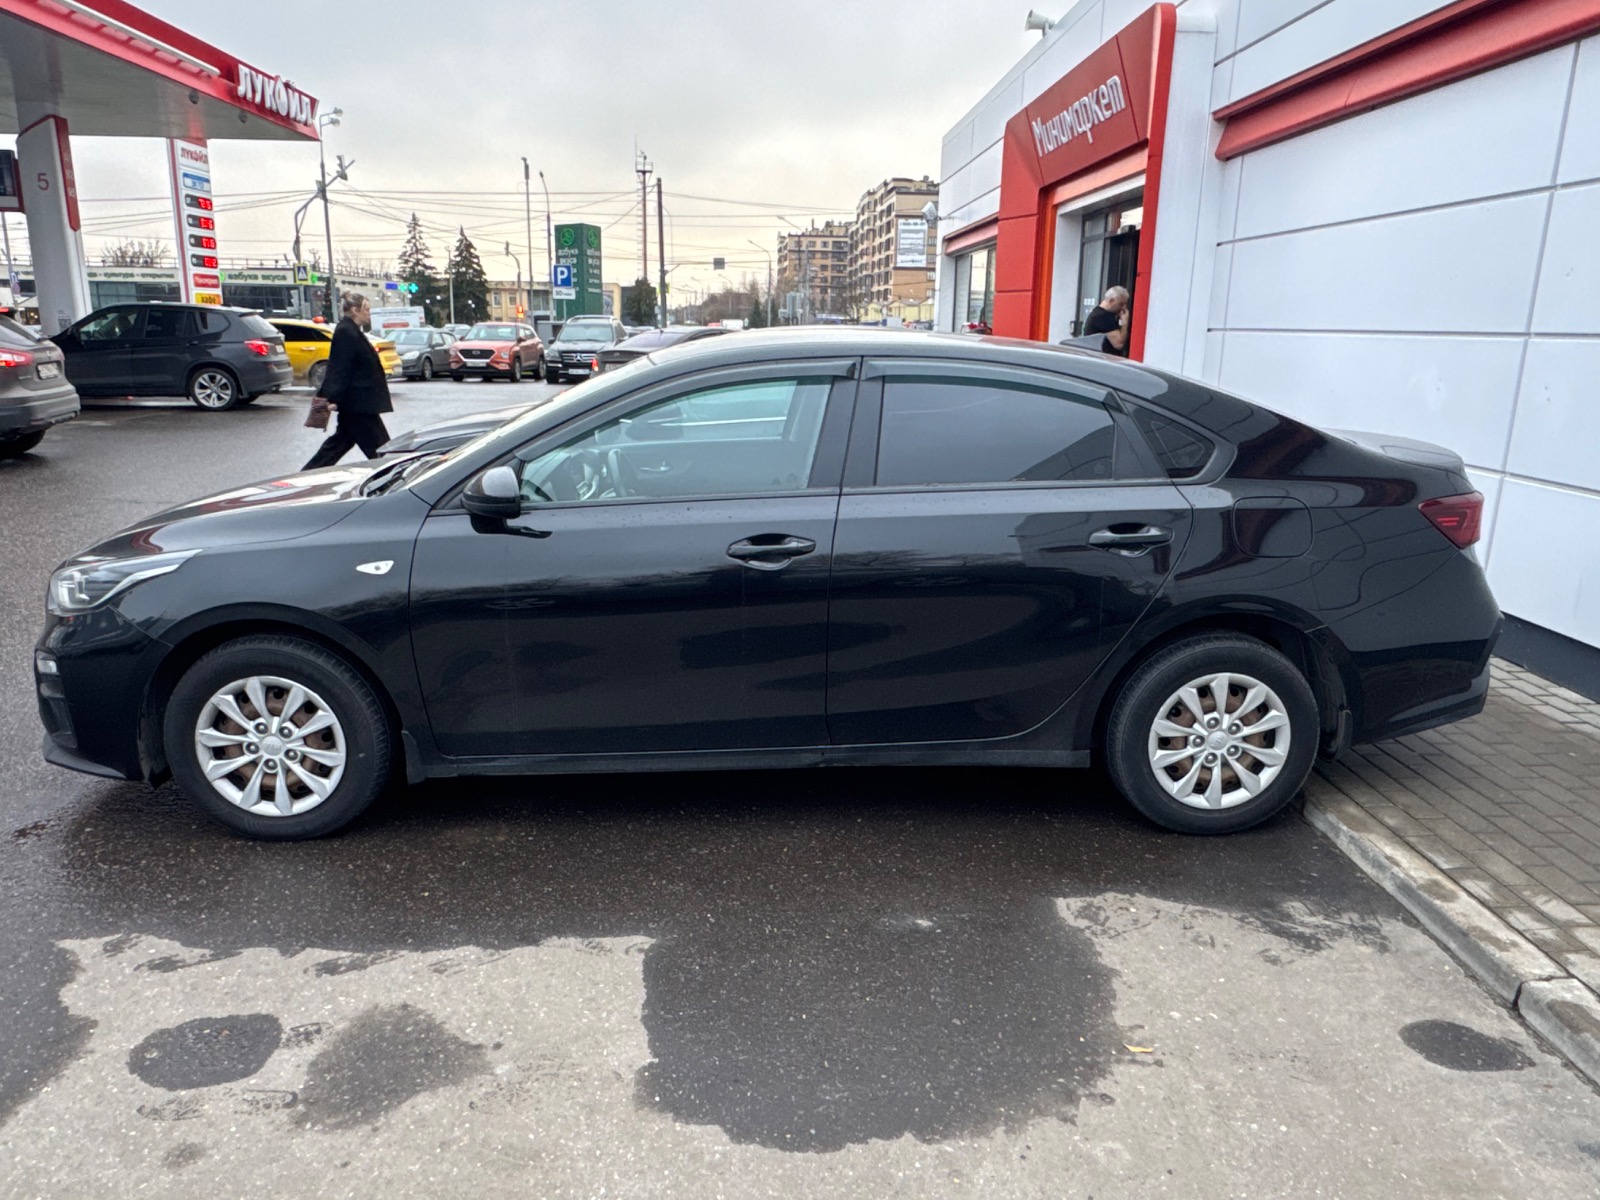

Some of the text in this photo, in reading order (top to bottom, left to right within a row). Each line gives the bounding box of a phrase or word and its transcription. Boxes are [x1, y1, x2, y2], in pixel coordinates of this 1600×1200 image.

[237, 63, 313, 128] ЛУКОЙЛ
[1031, 75, 1126, 157] Минимаркет
[37, 172, 50, 191] 5
